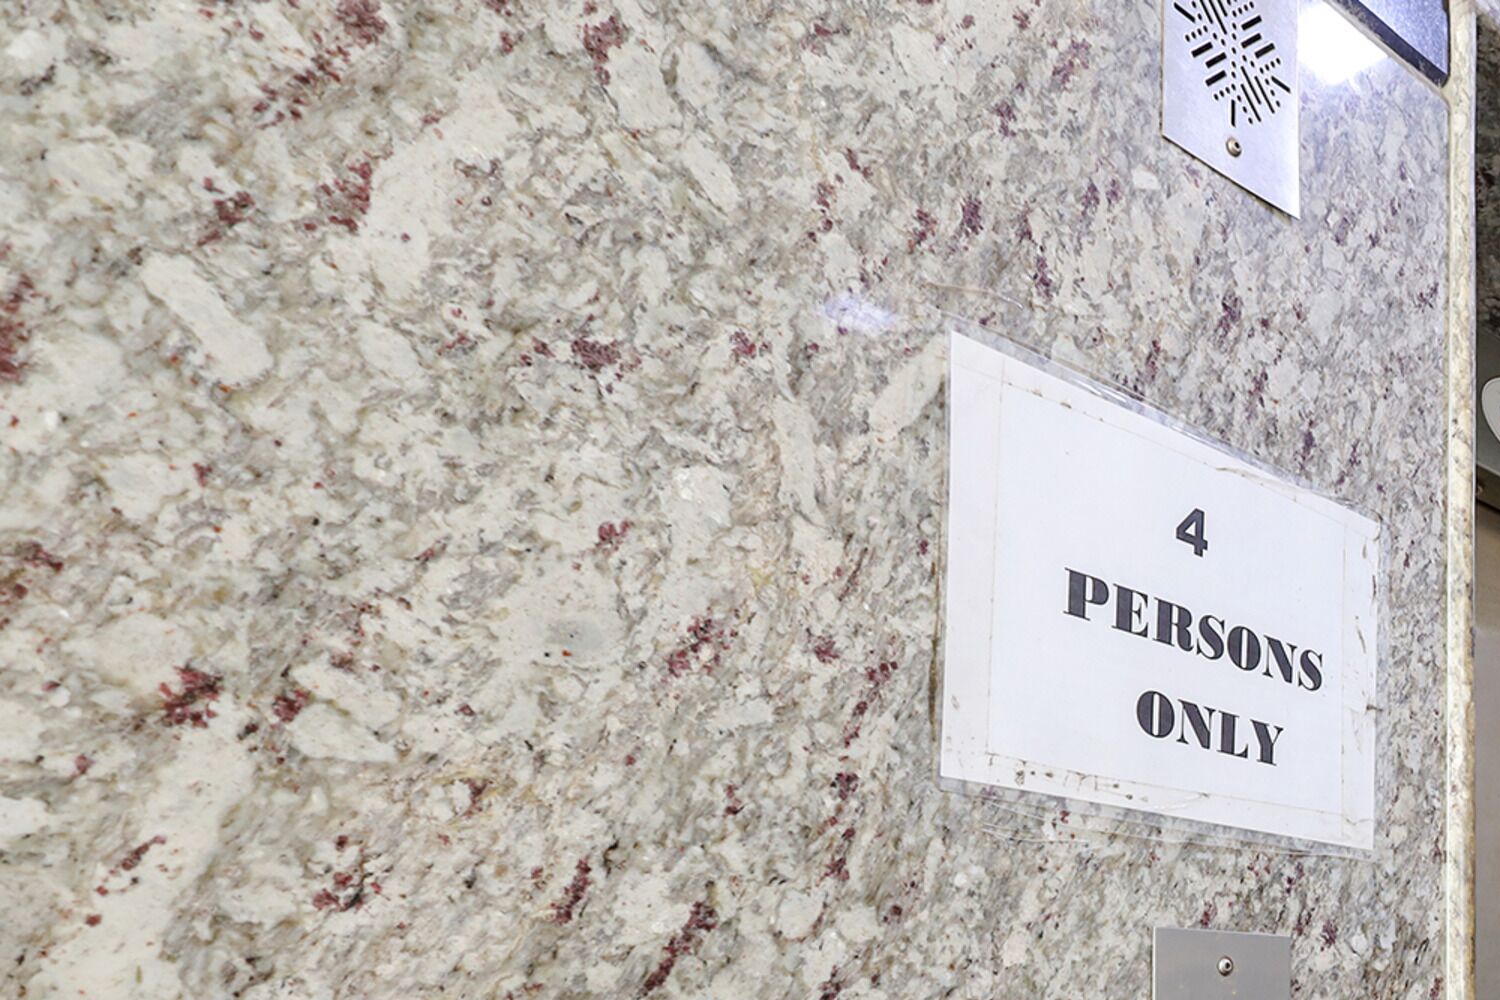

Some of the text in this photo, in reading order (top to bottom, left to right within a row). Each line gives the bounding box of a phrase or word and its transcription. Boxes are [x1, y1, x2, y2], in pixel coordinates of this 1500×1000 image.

[1175, 508, 1209, 558] 4
[1063, 567, 1324, 692] PERSONS
[1136, 690, 1284, 766] ONLY
